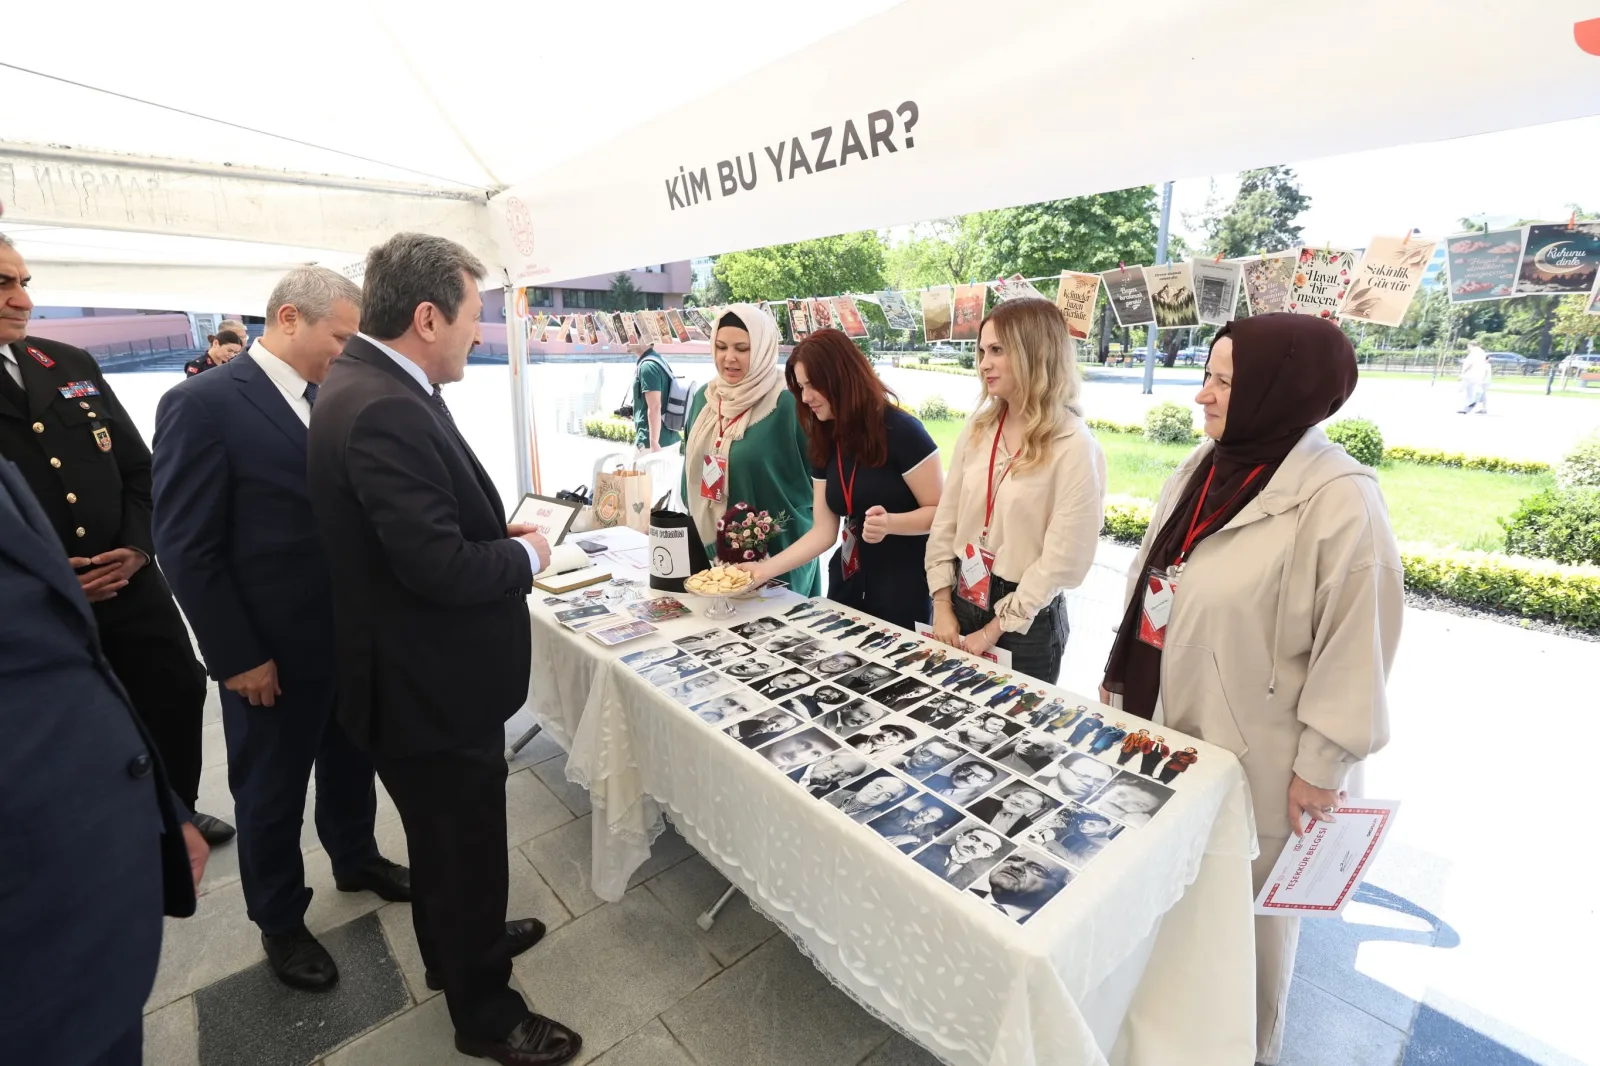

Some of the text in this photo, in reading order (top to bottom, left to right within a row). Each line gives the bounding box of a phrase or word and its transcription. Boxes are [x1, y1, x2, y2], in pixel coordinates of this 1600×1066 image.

[665, 100, 920, 211] KİM BU YAZAR?
[1306, 270, 1338, 284] Hayat
[1364, 264, 1409, 279] Sakinlik
[1310, 283, 1328, 294] bir
[1286, 856, 1311, 891] TEŞEKKÜR
[1306, 827, 1328, 856] BELGESİ
